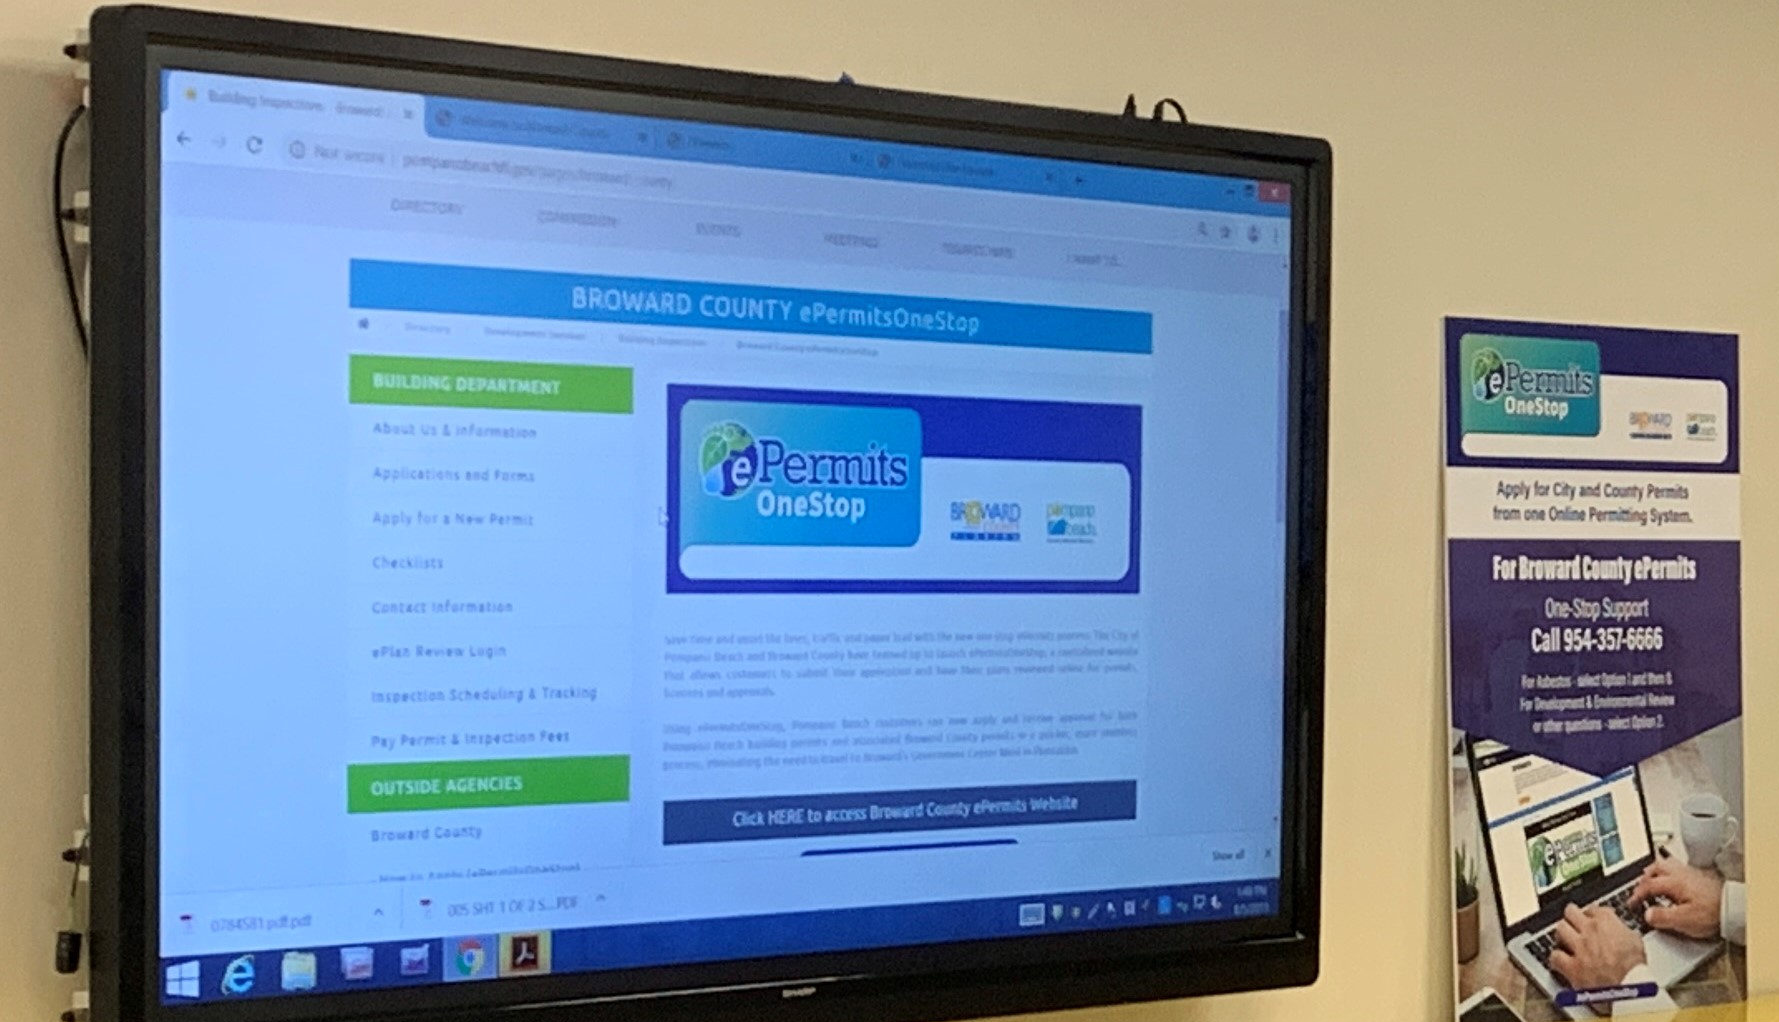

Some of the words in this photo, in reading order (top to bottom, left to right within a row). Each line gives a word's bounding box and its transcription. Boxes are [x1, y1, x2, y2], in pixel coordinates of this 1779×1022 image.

[571, 286, 692, 316] BROWARD
[699, 294, 792, 321] COUNTY
[799, 301, 980, 337] ePermitsOneStop
[372, 371, 450, 391] BUILDING
[456, 375, 561, 395] DEPARTMENT
[1488, 361, 1594, 396] ePermits
[1504, 396, 1568, 420] OneStop
[373, 422, 415, 436] About
[420, 424, 437, 437] Us
[731, 439, 908, 487] ePermits
[373, 467, 460, 482] Applications
[465, 469, 489, 482] and
[494, 470, 535, 483] Forms
[1497, 481, 1530, 499] Apply
[1534, 481, 1550, 497] for
[1553, 482, 1575, 501] City
[1579, 482, 1600, 498] and
[1604, 483, 1643, 501] County
[1647, 482, 1689, 500] Permits
[756, 489, 866, 524] OneStop
[1493, 506, 1520, 521] from
[1524, 508, 1545, 521] one
[1549, 506, 1586, 522] Online
[1589, 507, 1647, 526] Permitting
[1650, 507, 1693, 526] System.
[372, 511, 412, 527] Apply
[417, 511, 438, 525] for
[443, 515, 451, 526] a
[455, 513, 485, 526] New
[372, 556, 443, 570] Checklists
[1493, 555, 1517, 580] For
[1519, 554, 1580, 580] Broward
[1582, 555, 1632, 585] County
[1634, 555, 1697, 580] ePermits
[372, 601, 427, 614] Contact
[432, 600, 513, 613] Information
[1545, 597, 1600, 622] One-Stop
[1602, 597, 1649, 621] Support
[1531, 627, 1561, 653] Call
[1563, 626, 1663, 651] 954-357-6666
[415, 645, 465, 658] Review
[469, 645, 507, 660] Login
[371, 690, 445, 703] Inspection
[450, 688, 524, 703] Scheduling
[542, 686, 598, 702] Tracking
[371, 735, 395, 751] Pay
[401, 733, 447, 748] Permit
[464, 731, 536, 747] Inspection
[540, 730, 570, 743] Fees
[371, 779, 441, 796] OUTSIDE
[446, 776, 523, 793] AGENCIES
[732, 811, 765, 828] Click
[768, 808, 805, 826] HERE
[807, 808, 822, 824] to
[825, 806, 868, 823] access
[870, 803, 924, 820] Broward
[926, 802, 970, 820] County
[1030, 795, 1079, 812] Website
[370, 826, 430, 842] Broward
[434, 825, 483, 840] County
